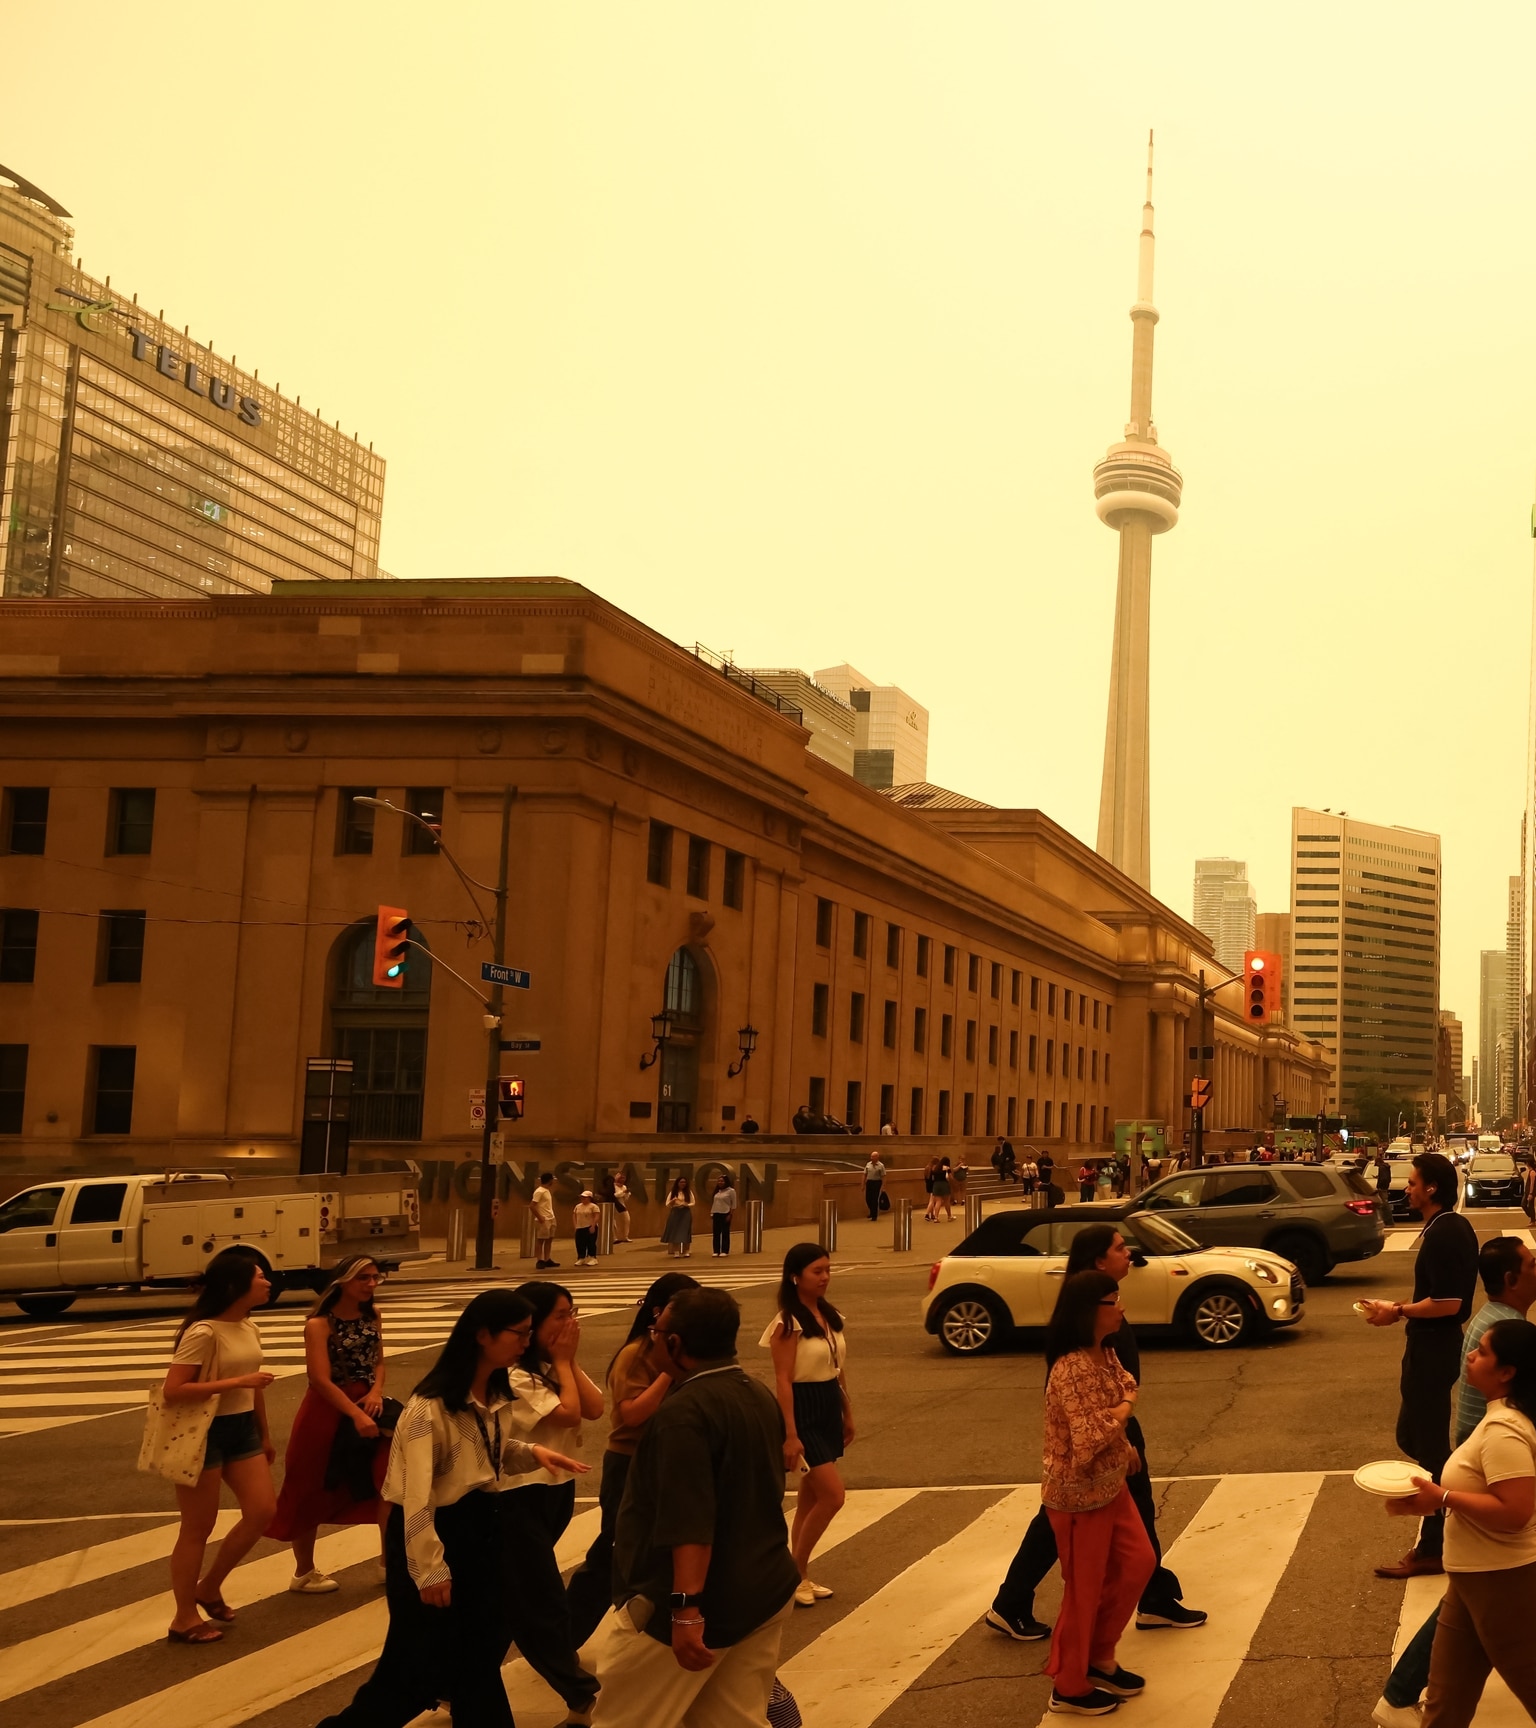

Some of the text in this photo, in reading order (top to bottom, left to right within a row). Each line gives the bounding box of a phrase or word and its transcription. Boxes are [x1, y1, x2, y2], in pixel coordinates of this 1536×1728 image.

[126, 326, 262, 427] TELUS
[490, 966, 509, 981] Front
[514, 971, 522, 984] W
[510, 1041, 522, 1050] Bay
[663, 1084, 671, 1097] 61
[553, 1159, 778, 1205] STATION
